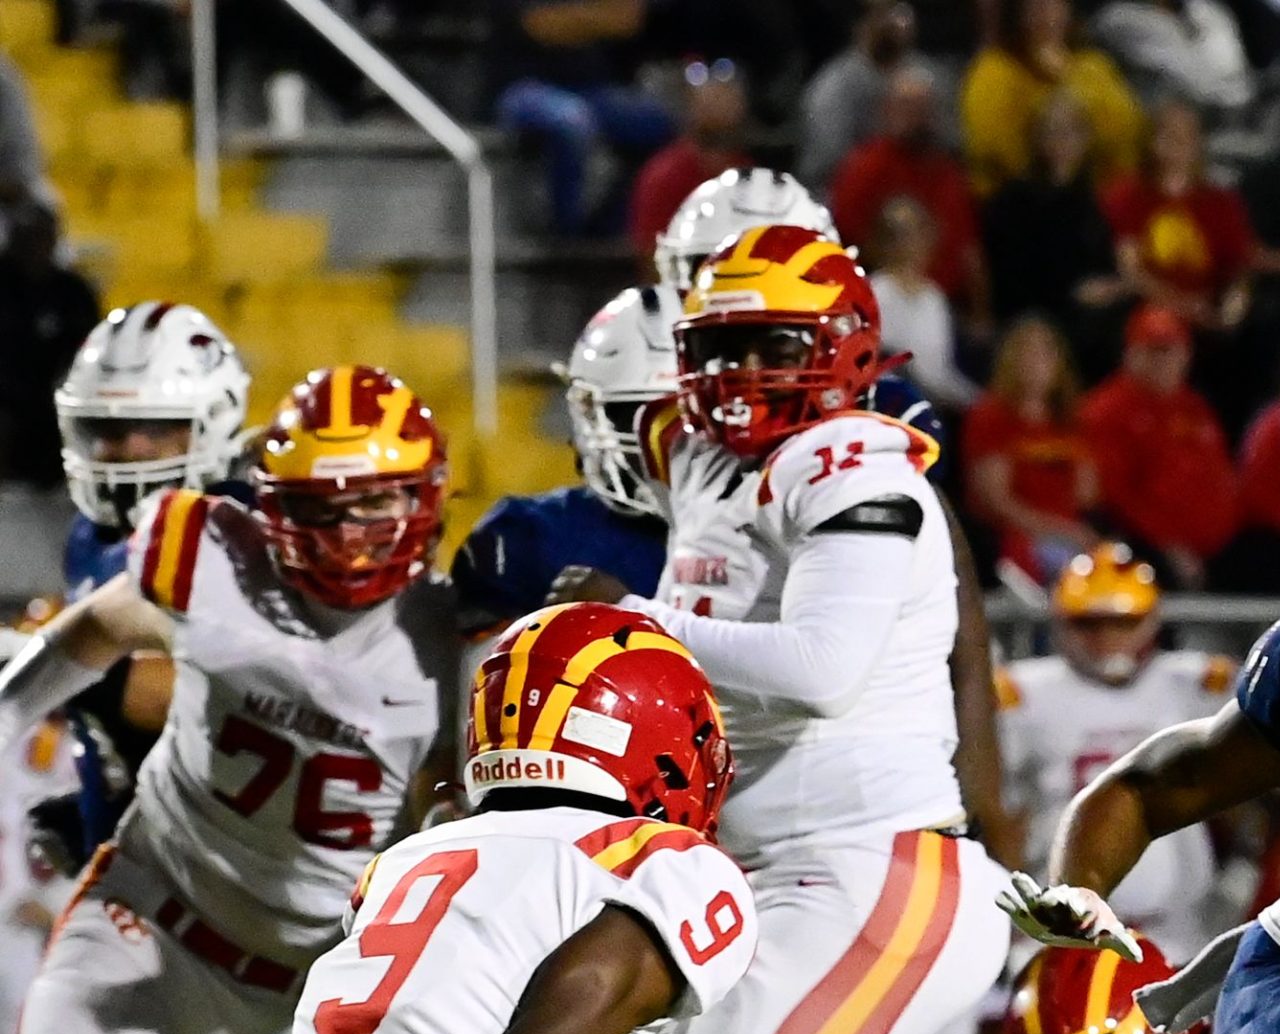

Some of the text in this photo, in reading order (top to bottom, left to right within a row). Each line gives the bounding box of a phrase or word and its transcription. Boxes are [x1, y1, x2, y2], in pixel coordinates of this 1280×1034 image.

[527, 688, 541, 707] 9
[213, 714, 384, 852] 76
[471, 757, 565, 784] Riddell
[680, 890, 744, 967] 9
